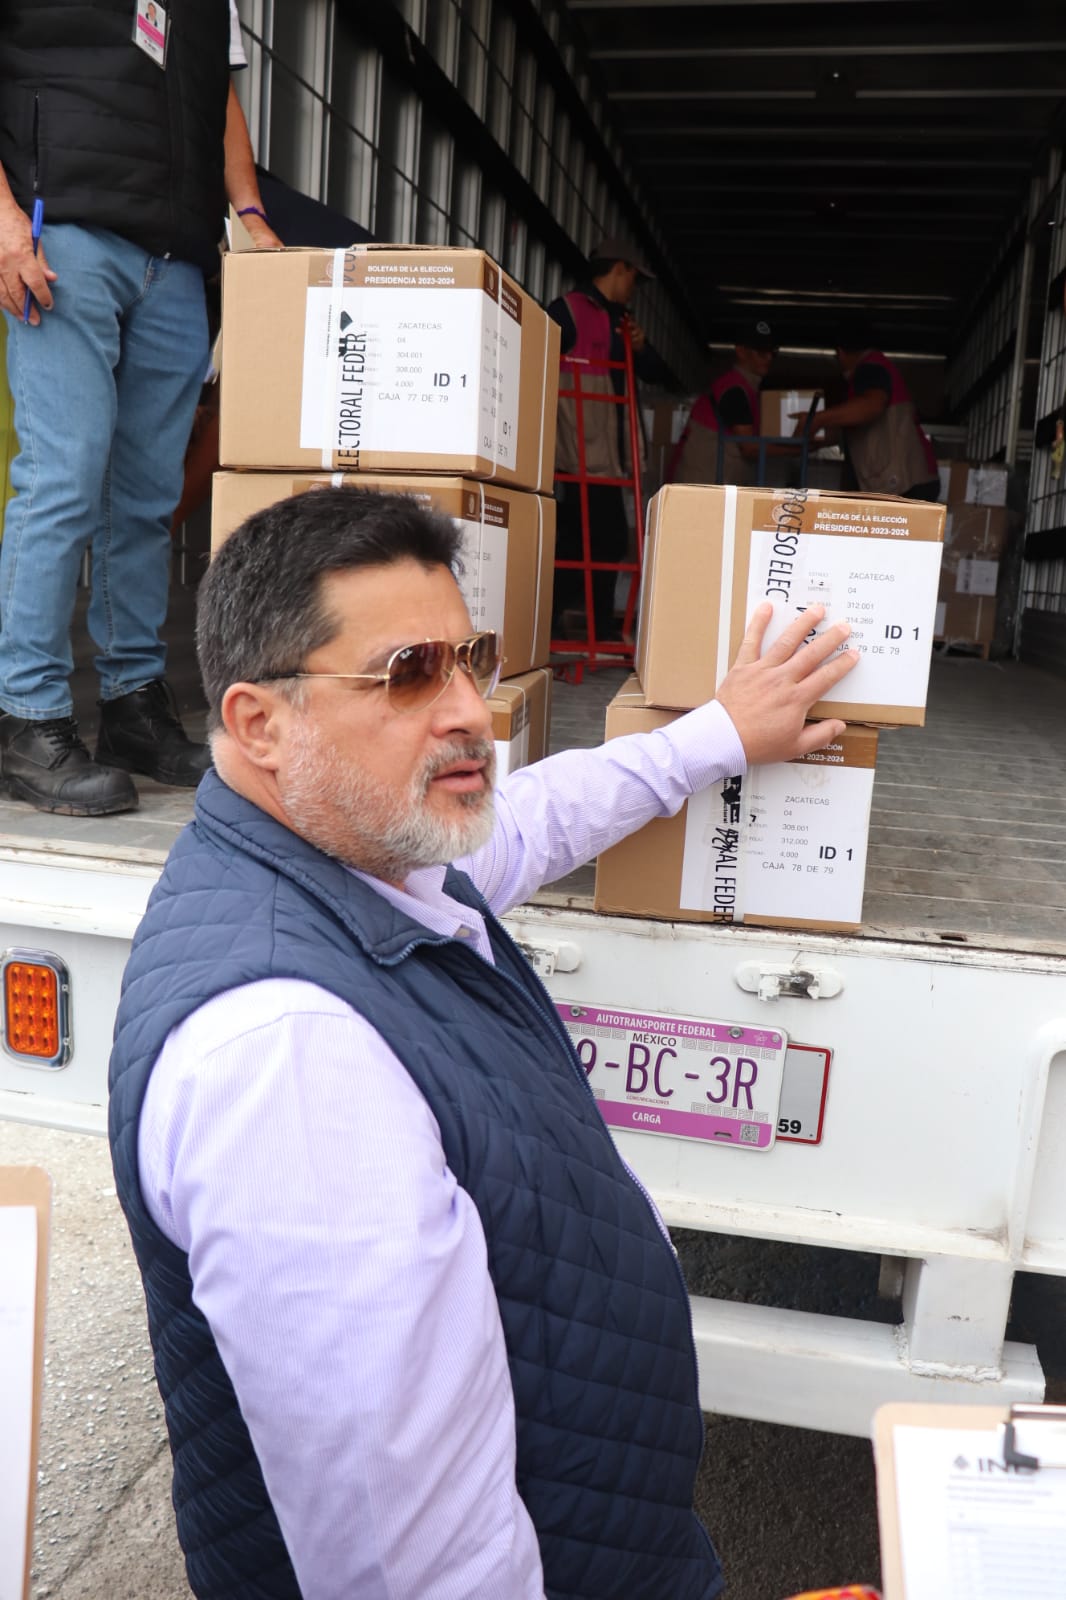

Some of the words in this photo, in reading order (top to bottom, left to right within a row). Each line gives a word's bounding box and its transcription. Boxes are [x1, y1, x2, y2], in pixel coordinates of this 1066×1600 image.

[420, 264, 454, 273] ELECCIÓN
[364, 276, 416, 284] PRESIDENCIA
[434, 372, 450, 387] ID
[460, 374, 467, 388] 1
[378, 392, 400, 401] CAJA
[422, 394, 434, 402] DE
[817, 512, 850, 520] BOLETAS
[872, 514, 908, 524] ELECCIÓN
[814, 523, 869, 534] PRESIDENCIA
[870, 526, 910, 536] 2023-2024
[848, 572, 895, 582] ZACATECAS
[884, 625, 903, 639] ID
[912, 626, 920, 640] 1
[857, 644, 868, 652] 79
[872, 646, 884, 654] DE
[889, 647, 900, 655] 79
[806, 754, 845, 763] 2023-2024
[784, 795, 830, 806] ZACATECAS
[819, 846, 836, 860] ID
[846, 848, 853, 861] 1
[762, 861, 785, 870] CAJA
[792, 864, 802, 872] 78
[807, 865, 820, 873] DE
[824, 866, 834, 874] 79
[596, 1013, 676, 1033] AUTOTRANSPORTE
[677, 1024, 716, 1038] FEDERAL
[632, 1031, 676, 1047] MÉXICO
[632, 1111, 661, 1124] CARGA
[778, 1118, 802, 1134] 59
